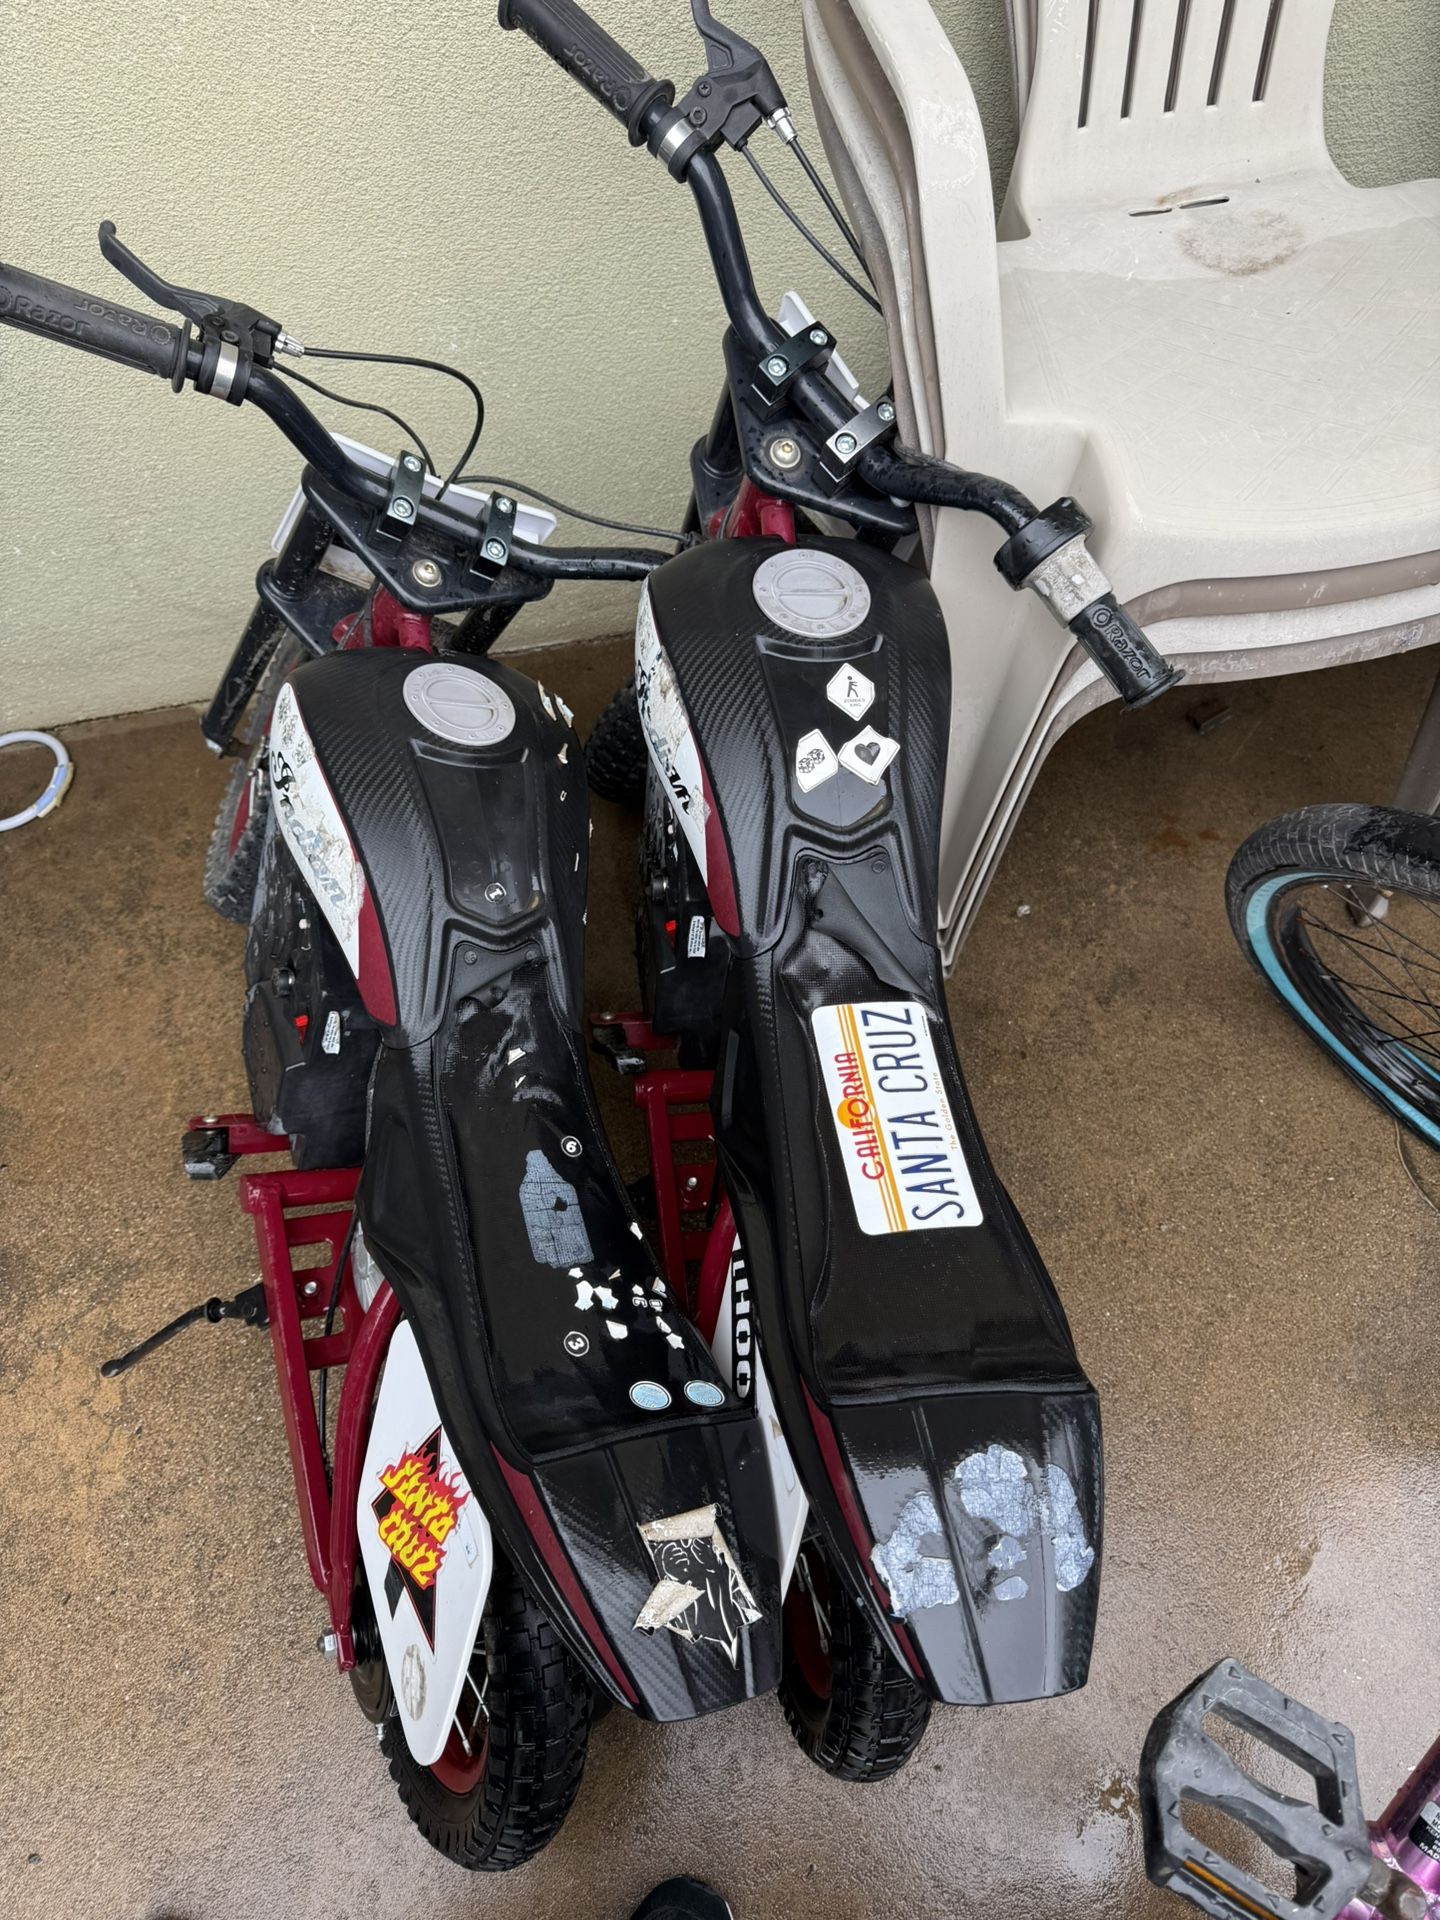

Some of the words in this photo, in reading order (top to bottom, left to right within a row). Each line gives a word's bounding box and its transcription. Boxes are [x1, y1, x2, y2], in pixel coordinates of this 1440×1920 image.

[14, 295, 91, 335] Razor
[73, 299, 148, 335] Razor
[1104, 623, 1152, 679] Razor
[860, 1008, 928, 1093] CRUZ
[933, 1072, 943, 1095] State
[834, 1052, 885, 1180] CALIFORNIA
[940, 1098, 952, 1131] Golden
[949, 1134, 958, 1150] The
[887, 1110, 965, 1221] SANTA
[382, 1459, 455, 1543] SANTA
[379, 1509, 440, 1585] CRUZ
